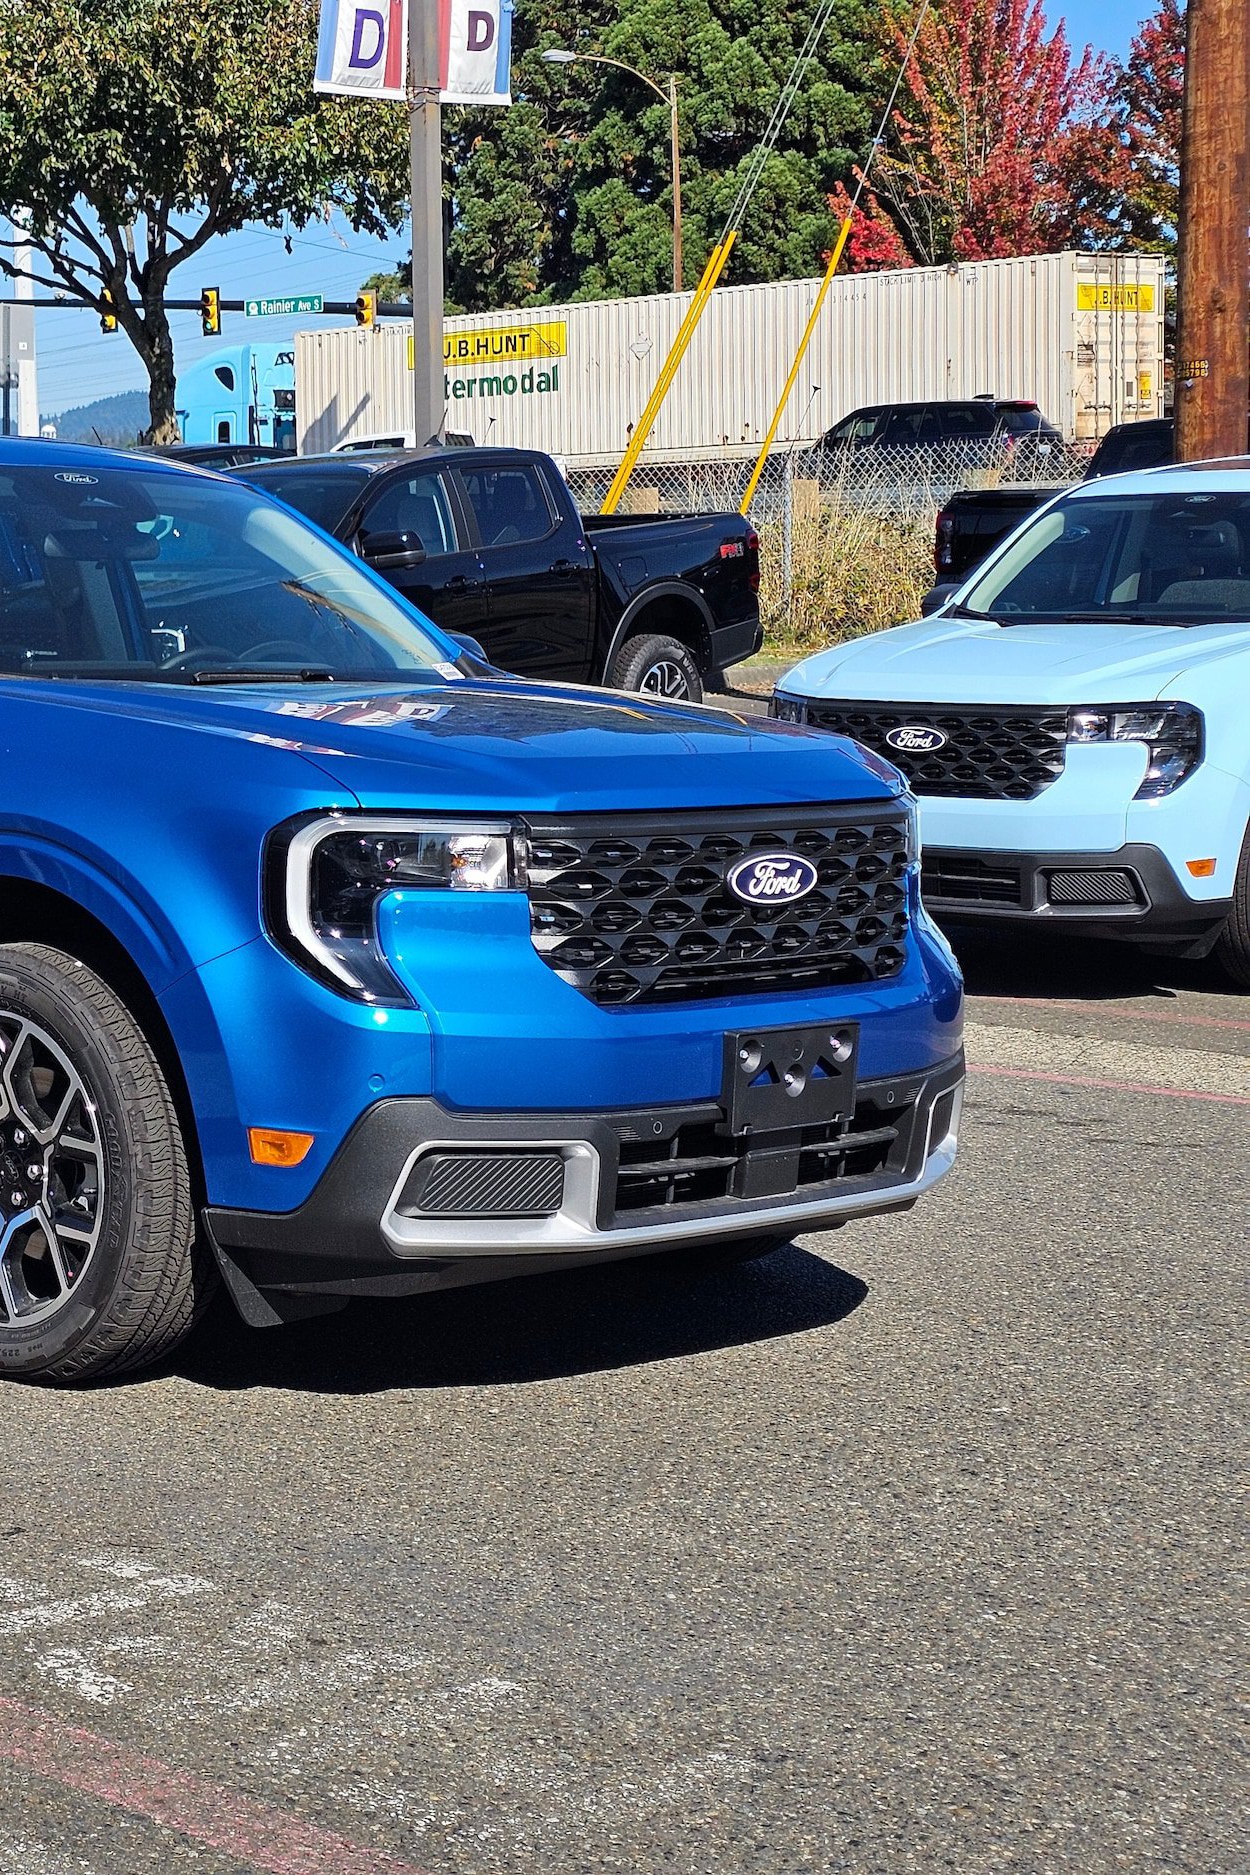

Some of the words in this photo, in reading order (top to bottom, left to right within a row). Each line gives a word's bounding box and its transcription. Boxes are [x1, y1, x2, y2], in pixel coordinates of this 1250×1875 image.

[261, 300, 295, 315] Rainier
[298, 302, 311, 311] Ave
[313, 299, 320, 310] S
[443, 333, 530, 359] J.B.HUNT
[444, 364, 559, 400] termodal
[748, 861, 803, 896] Ford
